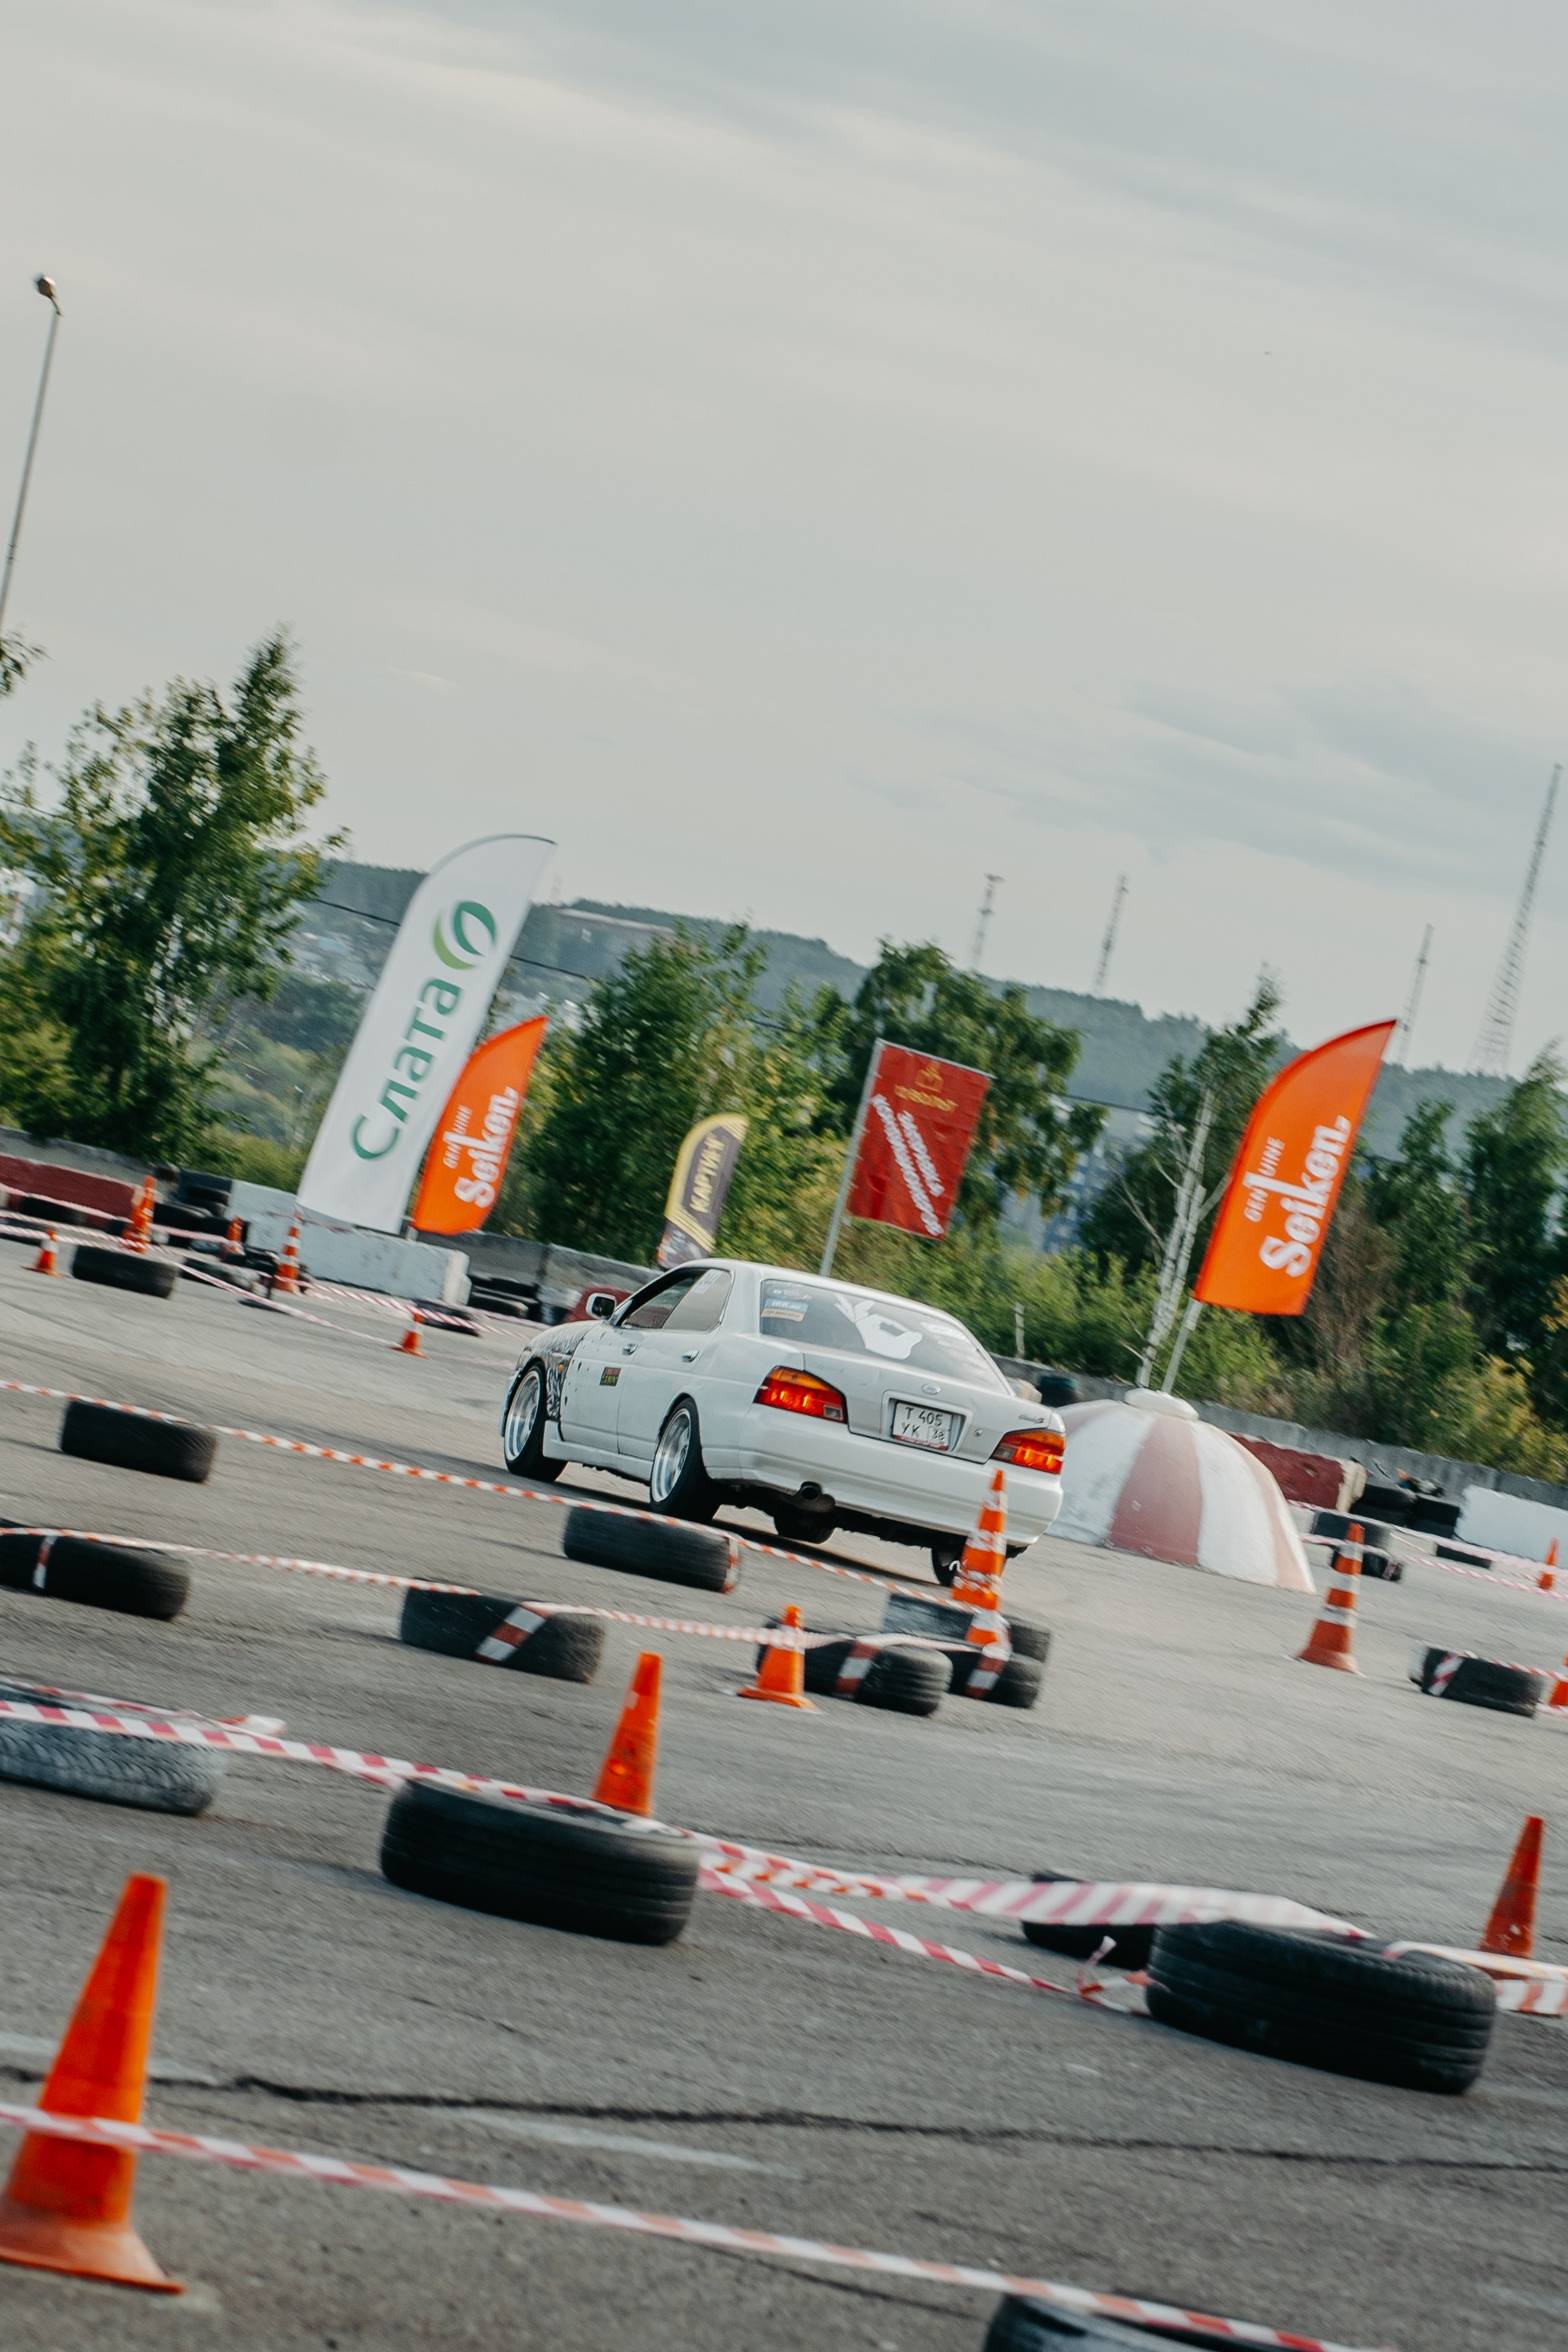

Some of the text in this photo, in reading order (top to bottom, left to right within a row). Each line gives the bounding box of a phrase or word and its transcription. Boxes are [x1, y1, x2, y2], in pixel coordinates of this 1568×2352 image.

[351, 977, 462, 1160] Слата
[1243, 1115, 1352, 1278] Seiken
[918, 1410, 943, 1427] 405
